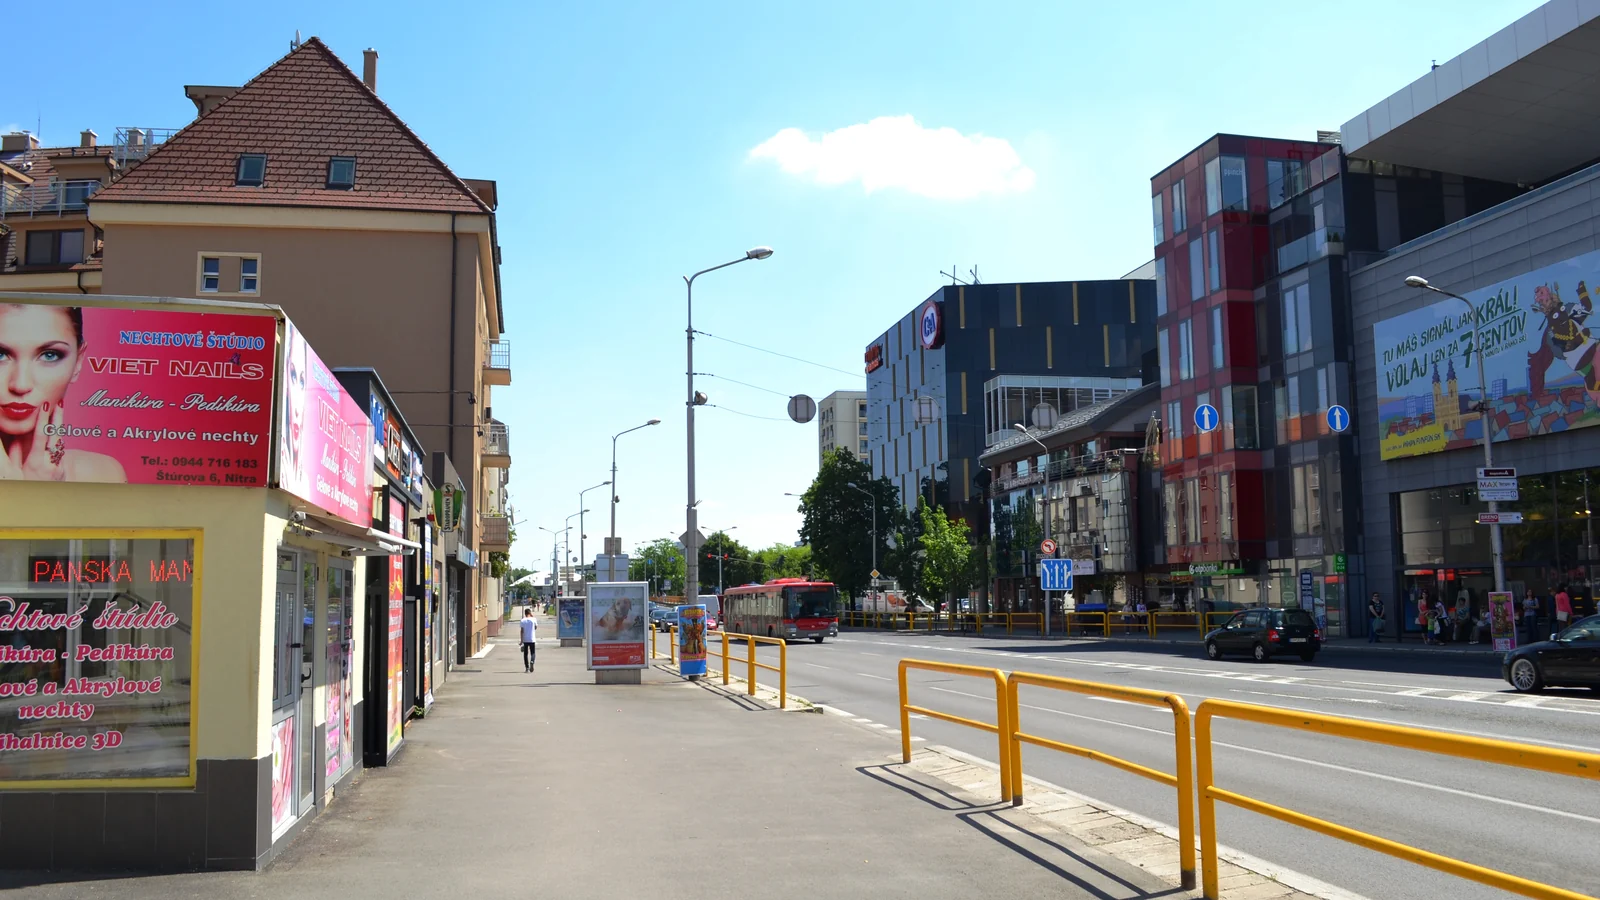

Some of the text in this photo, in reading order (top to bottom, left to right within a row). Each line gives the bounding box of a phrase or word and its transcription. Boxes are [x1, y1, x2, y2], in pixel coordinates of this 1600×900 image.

[1383, 284, 1519, 366] TU MÁŠ SIGNÁL JAK KRÁL!
[119, 330, 266, 350] NECHTOVÉ ŠTÚDIO
[1386, 311, 1528, 393] VOLAJ LEN ZA 7 CENTOV
[88, 356, 264, 380] VIET NAILS
[80, 389, 164, 410] Manikúra
[180, 393, 260, 414] Pedikúra
[43, 424, 259, 446] Gélové a Akrylové nechty
[318, 396, 338, 443] VIET
[340, 418, 362, 464] NAILS
[141, 456, 258, 468] Tel.: 0944 716 183
[156, 470, 258, 484] Štúrova 6, Nitra
[34, 559, 193, 582] PANSKA MAN
[93, 601, 179, 630] štúdio
[76, 644, 174, 662] Pedikúra
[43, 681, 57, 696] a
[62, 676, 162, 698] Akrylové
[18, 700, 95, 722] nechty
[91, 731, 122, 750] 3D
